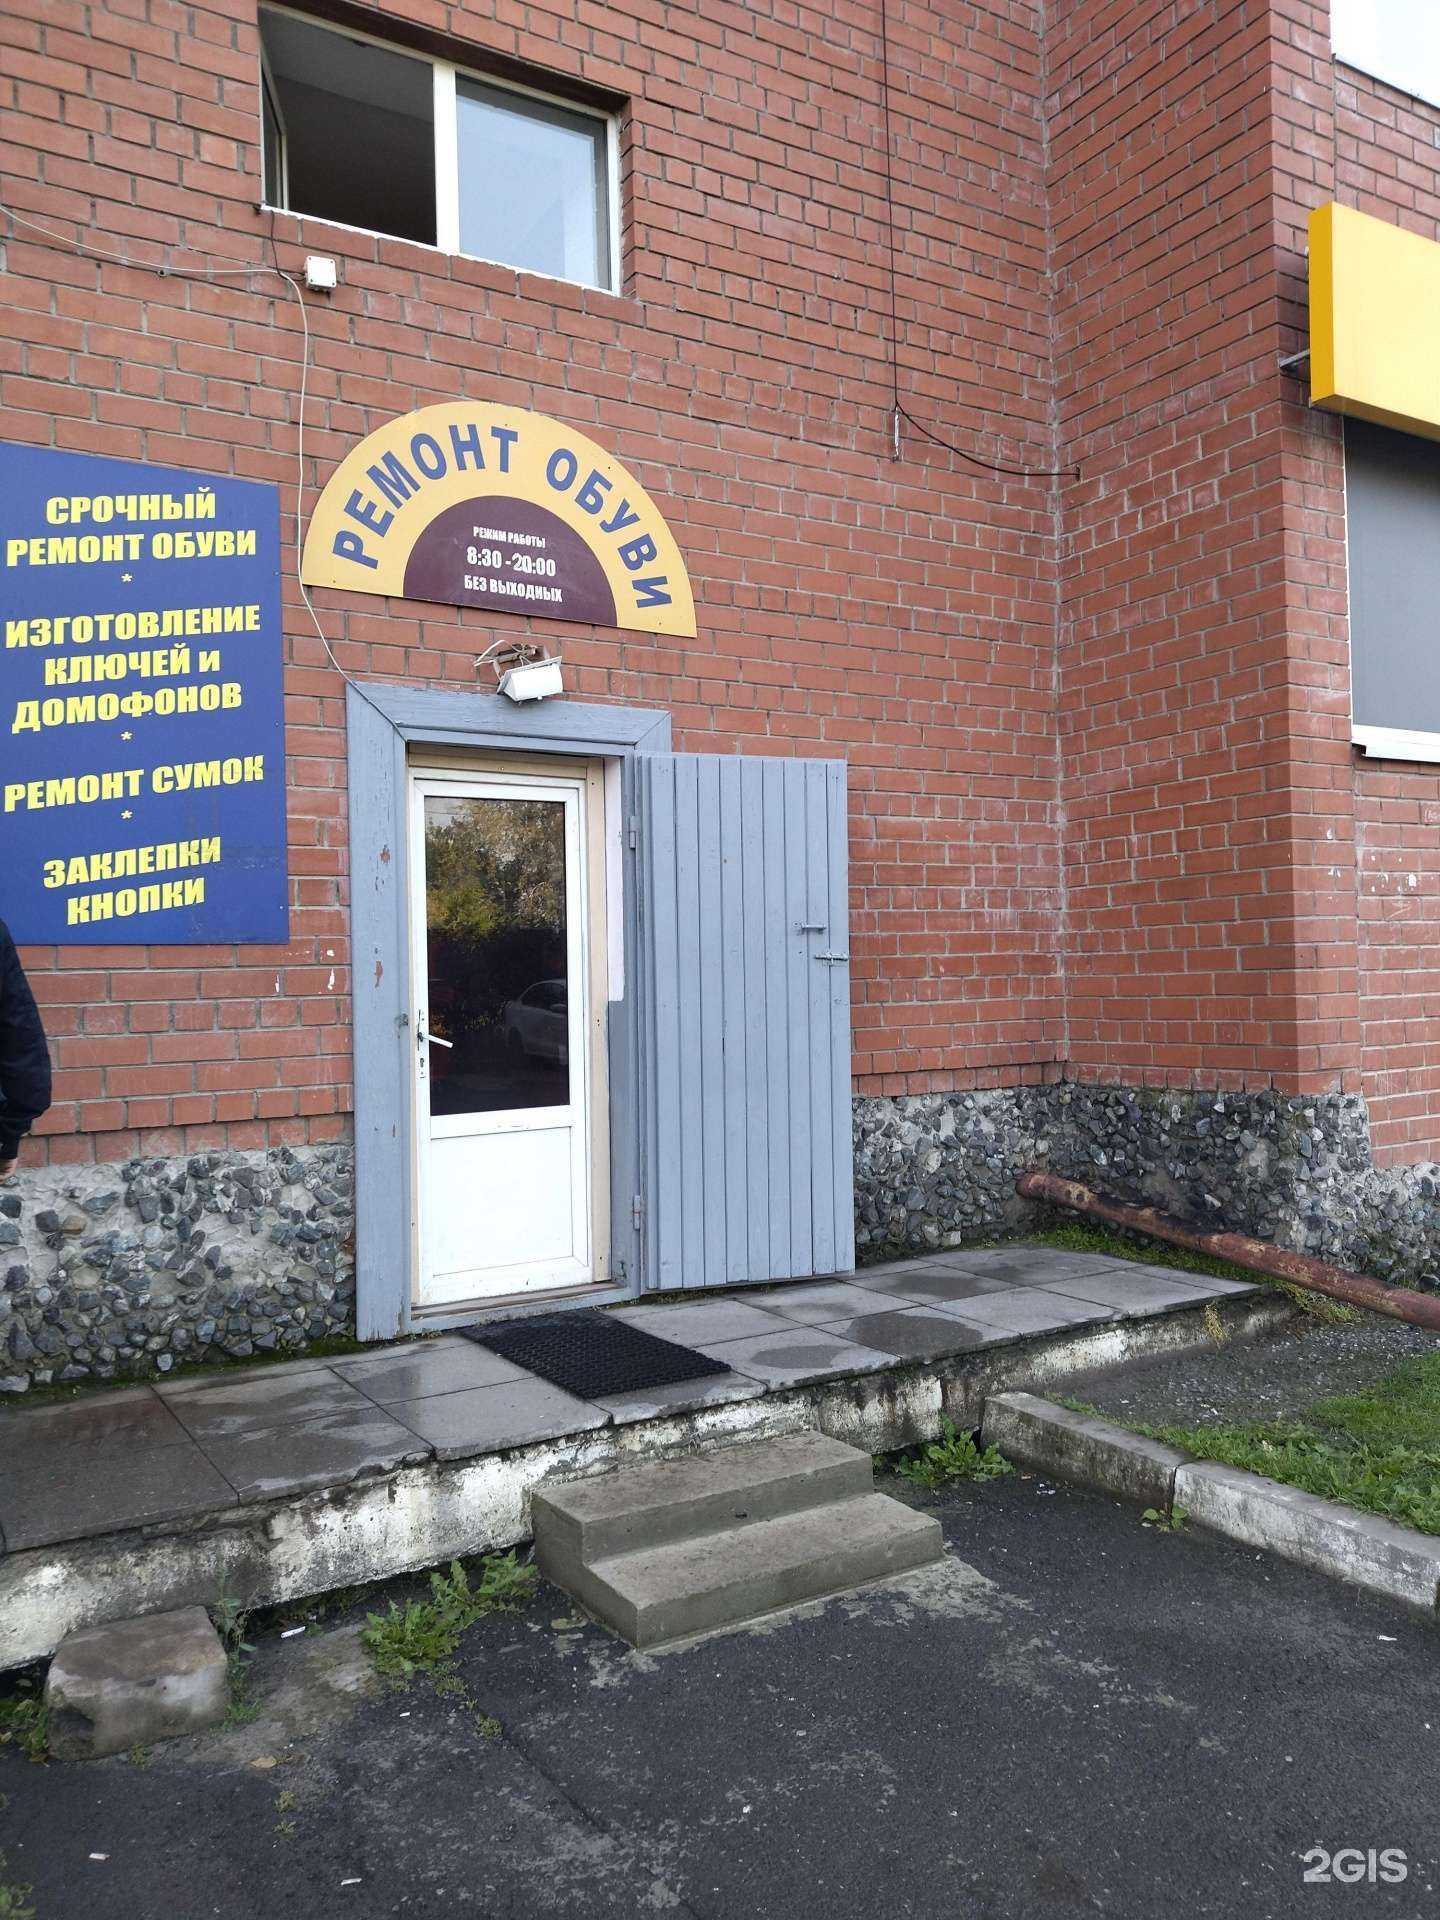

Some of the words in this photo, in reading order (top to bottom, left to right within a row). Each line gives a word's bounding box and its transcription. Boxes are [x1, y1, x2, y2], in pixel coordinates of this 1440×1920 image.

[46, 486, 216, 525] СРОЧНЫЙ
[332, 423, 518, 570] РЕМОНТ
[545, 447, 673, 609] ОБУВИ
[6, 533, 145, 567] РЕМОНТ
[151, 529, 257, 560] ОБУВИ
[466, 546, 502, 568] 8:30
[473, 526, 507, 543] РЕЖИМ
[507, 532, 546, 549] РАБОТЫ
[464, 574, 487, 592] БЕЗ
[489, 578, 563, 603] ВЫХОДНЫХ
[5, 604, 261, 649] ИЗГОТОВЛЕНИЕ
[44, 642, 191, 686] КЛЮЧЕЙ
[11, 682, 242, 735] ДОМОФОНОВ
[4, 769, 145, 813] РЕМОНТ
[152, 754, 264, 794] СУМОК
[43, 836, 221, 889] ЗАКЛЕПКИ
[67, 877, 205, 926] КНОПКИ
